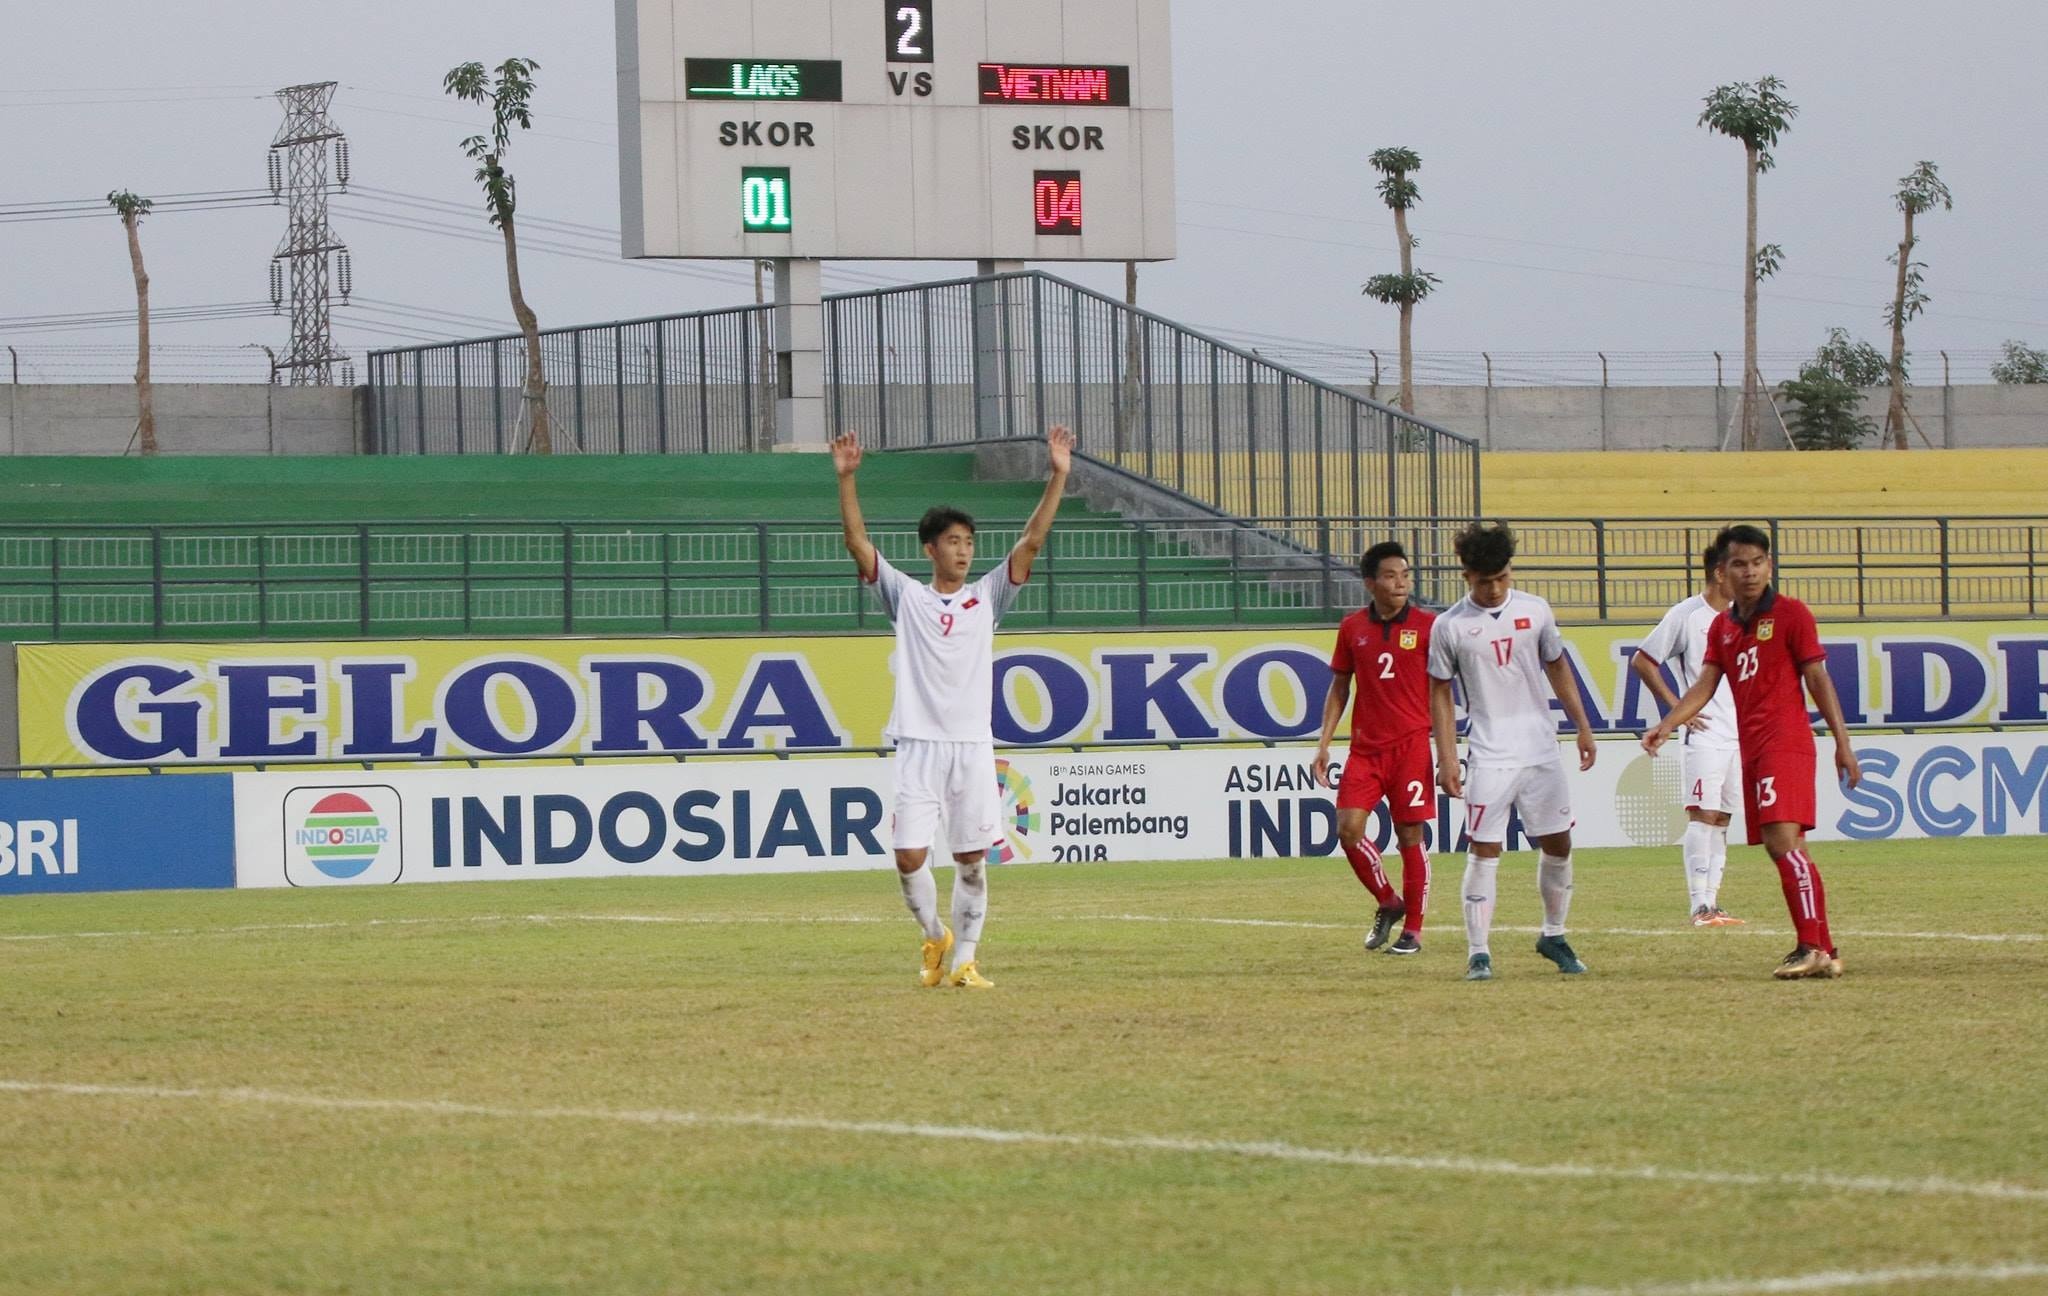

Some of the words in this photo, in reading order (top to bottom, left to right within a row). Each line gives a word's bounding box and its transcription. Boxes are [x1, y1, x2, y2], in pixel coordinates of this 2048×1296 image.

[897, 7, 921, 54] 2
[732, 64, 799, 95] LAOS
[889, 71, 932, 97] VS
[1000, 68, 1107, 101] VIETNAM
[719, 121, 815, 147] SKOR
[1012, 125, 1104, 151] SKOR
[743, 177, 790, 226] 01
[1035, 180, 1081, 227] 04
[940, 613, 954, 636] 9
[1378, 652, 1395, 679] 2
[1490, 637, 1513, 667] 17
[1737, 646, 1759, 682] 23
[76, 658, 841, 760] GELORA
[991, 649, 1335, 744] OKO
[1069, 765, 1103, 776] ASIAN
[1106, 764, 1146, 775] GAMES
[1225, 765, 1315, 792] ASIAN
[1051, 783, 1146, 807] Jakarta
[1407, 780, 1425, 807] 2
[1692, 778, 1703, 801] 4
[1836, 745, 2048, 840] SCM
[432, 786, 884, 868] INDOSIAR
[1051, 811, 1188, 840] Palembang
[1467, 803, 1486, 831] 17
[296, 828, 388, 845] INDOSIAR
